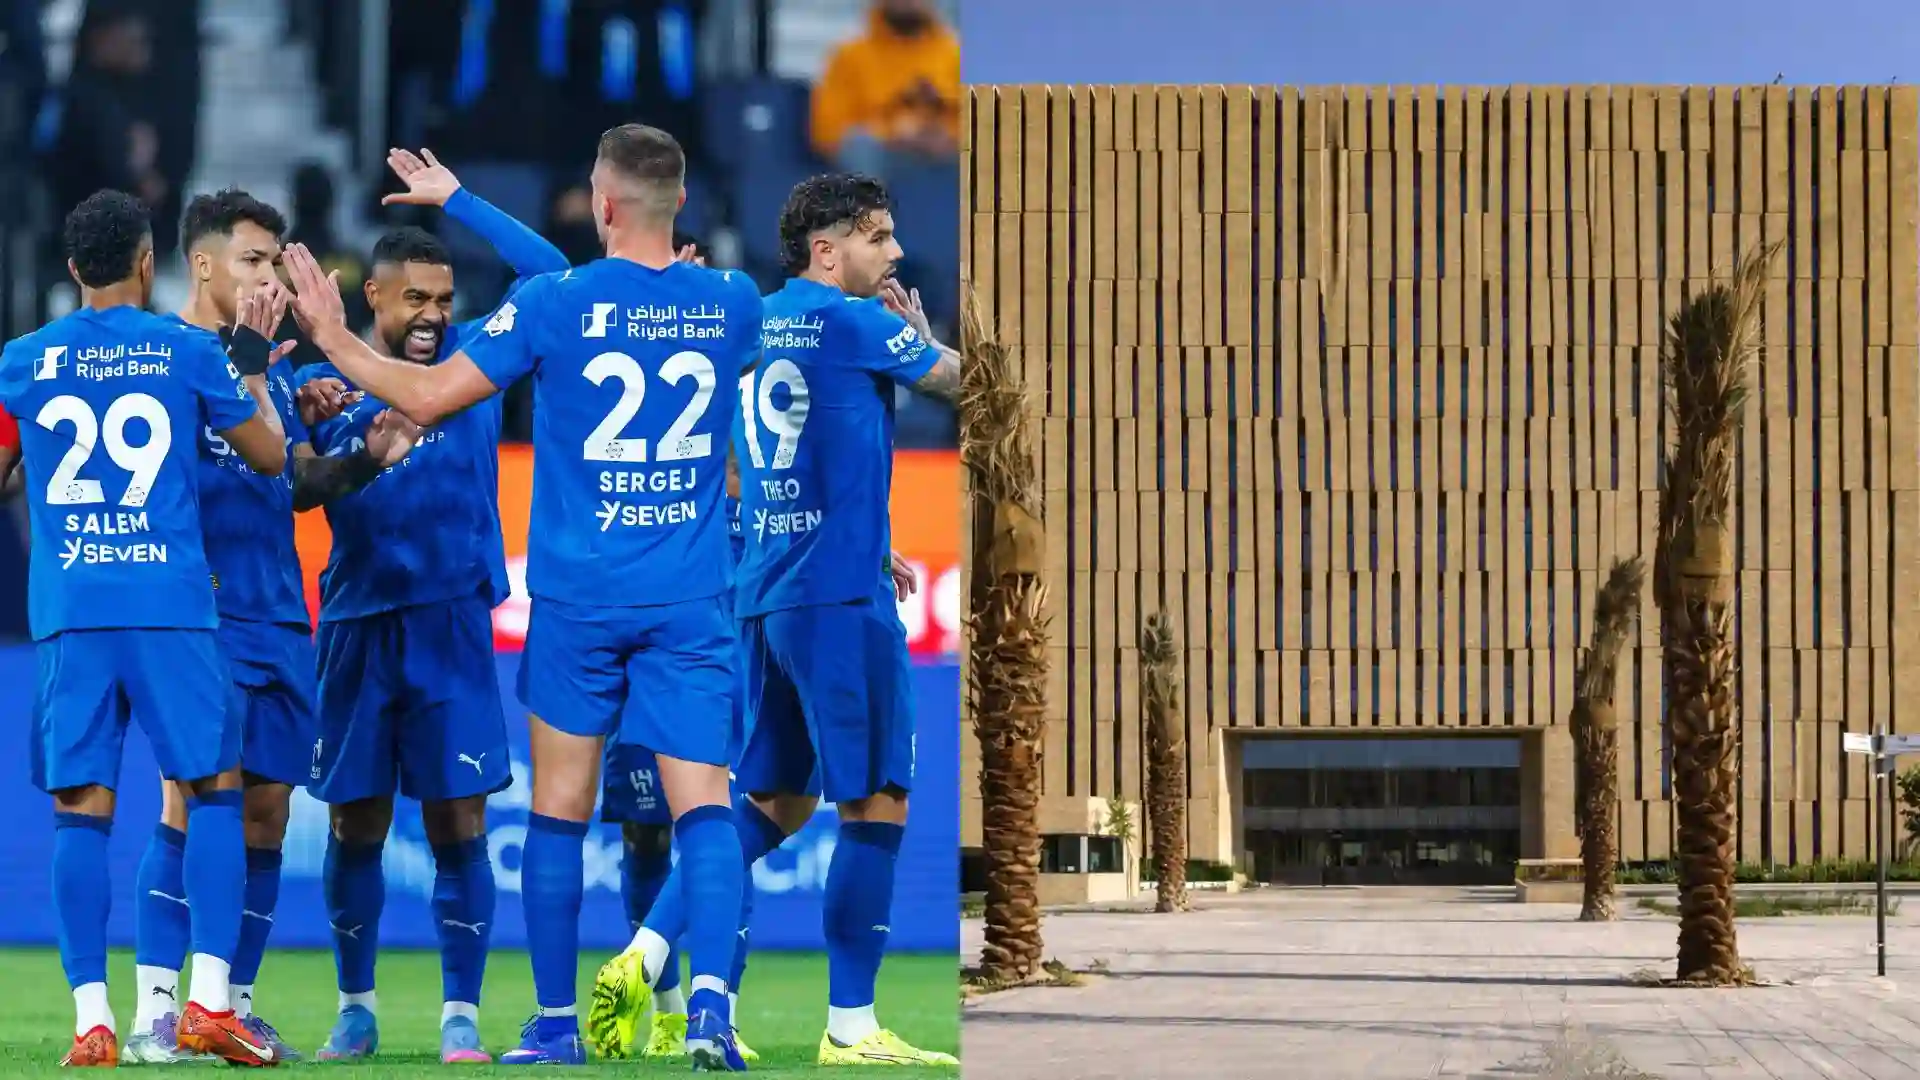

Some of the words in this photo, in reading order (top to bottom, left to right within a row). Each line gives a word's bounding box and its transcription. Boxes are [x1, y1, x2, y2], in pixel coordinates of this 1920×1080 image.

[626, 304, 677, 323] الرياض
[682, 304, 726, 322] بنك
[628, 322, 678, 340] Riyad
[683, 323, 725, 338] Bank
[760, 331, 784, 348] iyad
[786, 332, 820, 348] Bank
[77, 344, 124, 362] الرياض
[128, 342, 172, 360] بنك
[76, 363, 124, 381] Riyad
[127, 360, 170, 376] Bank
[582, 351, 716, 463] 22
[738, 358, 810, 470] 19
[35, 392, 172, 508] 29
[599, 467, 696, 493] SERGEJ
[761, 478, 800, 501] THEO
[64, 511, 150, 535] SALEM
